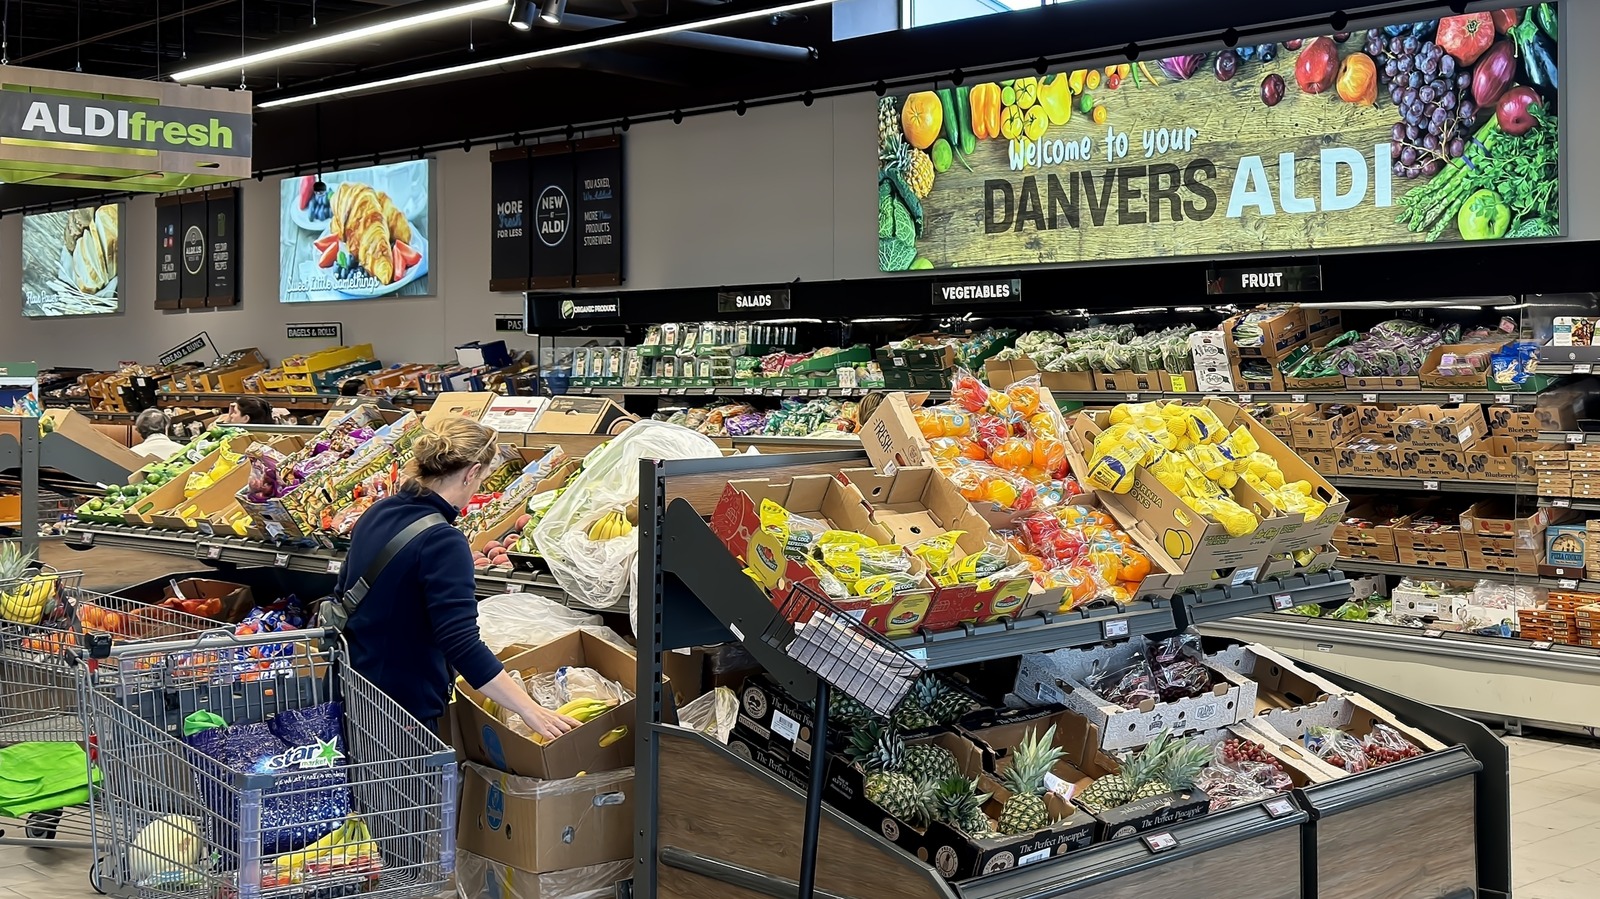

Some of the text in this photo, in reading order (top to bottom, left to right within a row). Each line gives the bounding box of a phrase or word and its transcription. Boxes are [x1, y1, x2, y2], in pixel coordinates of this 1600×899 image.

[21, 101, 233, 149] ALDIfresh
[1008, 125, 1199, 171] Welcome to your
[584, 177, 611, 190] YOU ASKED,
[984, 142, 1393, 235] DANVERS ALDI
[497, 200, 523, 215] MORE
[542, 195, 563, 210] NEW
[499, 213, 522, 229] Fresh
[584, 210, 612, 222] MORE New
[497, 228, 523, 239] FOR LESS
[541, 219, 564, 234] ALDI
[585, 222, 610, 234] PRODUCTS
[287, 271, 381, 294] Sweet Little Somethings
[1241, 272, 1283, 289] FRUIT
[941, 283, 1011, 300] VEGETABLES
[594, 304, 617, 312] PRODUCE
[735, 294, 772, 308] SALADS
[288, 327, 336, 337] BAGELS & ROLLS
[162, 339, 204, 366] BREAD & BUNS
[874, 420, 893, 453] FRESH
[1417, 468, 1451, 476] Blueberries
[1484, 471, 1520, 479] Blueberries
[1130, 487, 1151, 509] ONS
[1134, 478, 1163, 509] ORNIA
[797, 535, 811, 543] COOL
[771, 695, 802, 720] The Perfect
[268, 745, 321, 768] star
[301, 758, 327, 767] market
[756, 750, 768, 765] The
[768, 759, 787, 779] Perfect
[1141, 806, 1202, 829] The Perfect Pineapple
[1020, 830, 1087, 854] The Perfect Pineapple
